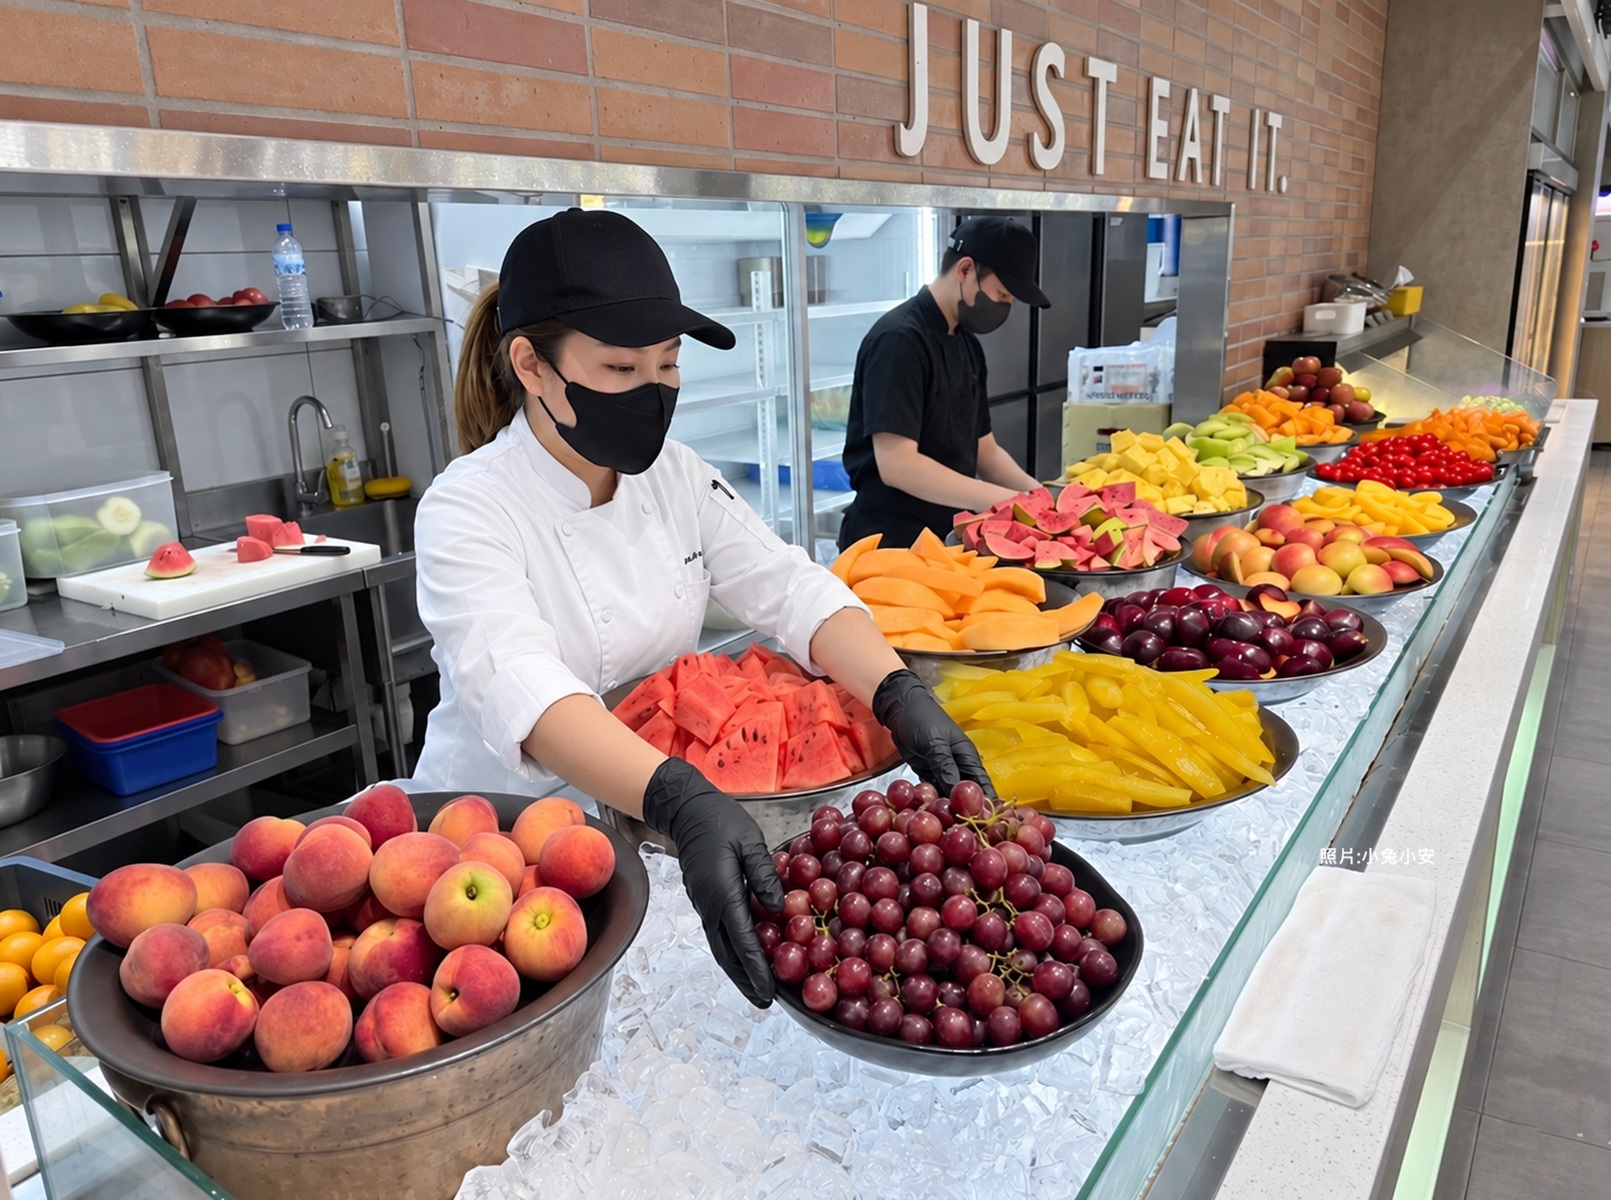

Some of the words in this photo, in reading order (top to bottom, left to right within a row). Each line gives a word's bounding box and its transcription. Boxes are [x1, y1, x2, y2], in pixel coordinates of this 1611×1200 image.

[894, 2, 1117, 176] JUST
[1146, 76, 1230, 187] EAT
[1248, 108, 1288, 194] IT.
